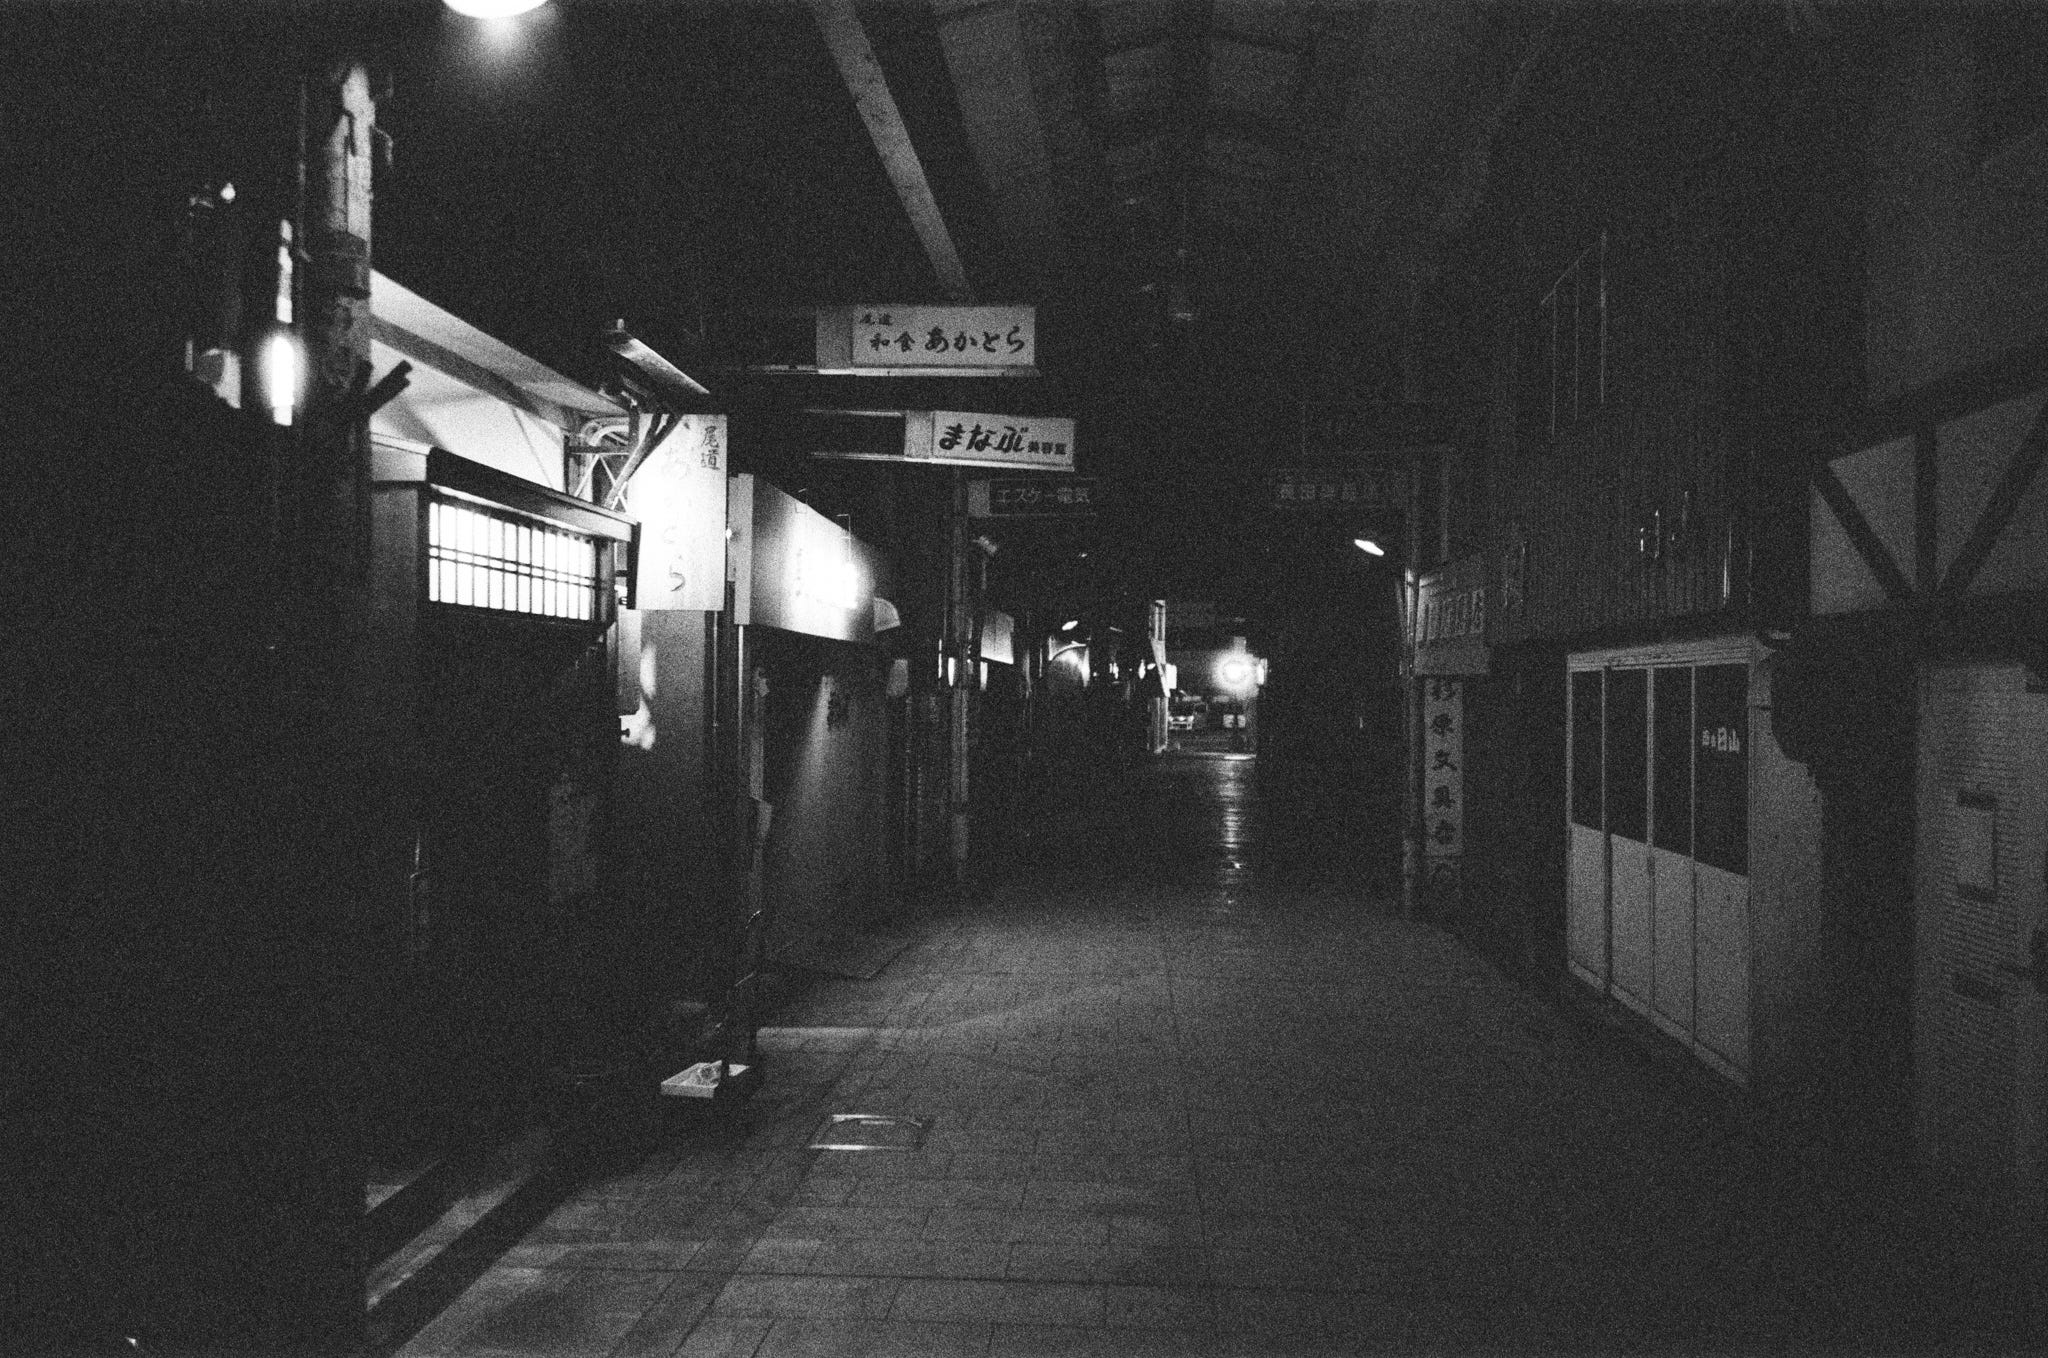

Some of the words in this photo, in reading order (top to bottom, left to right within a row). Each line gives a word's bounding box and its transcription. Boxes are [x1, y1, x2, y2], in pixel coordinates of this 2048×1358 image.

[925, 325, 1025, 353] あかとら
[938, 423, 1029, 454] まなぶ
